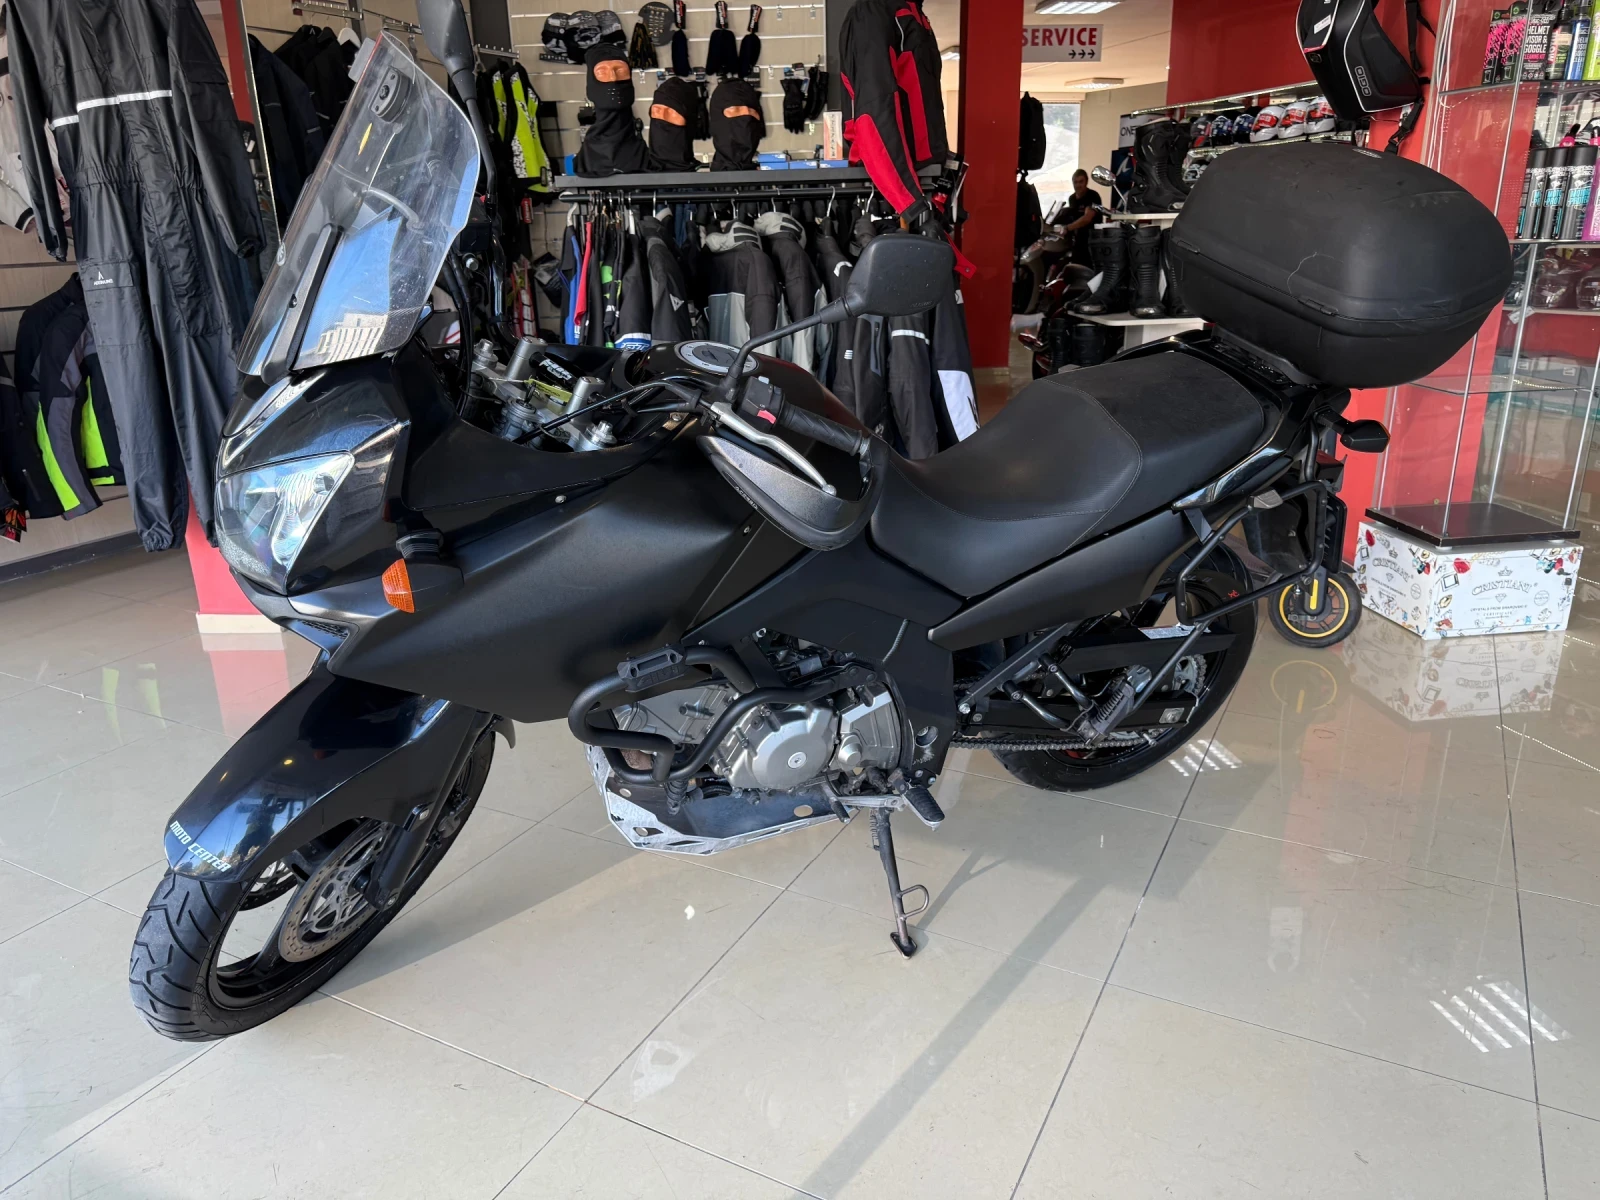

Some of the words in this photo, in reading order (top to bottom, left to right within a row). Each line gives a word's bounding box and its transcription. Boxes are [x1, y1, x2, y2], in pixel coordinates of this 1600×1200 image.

[1022, 27, 1098, 47] SERVICE
[1527, 25, 1550, 35] HELMET
[1524, 44, 1547, 54] GOGGLE
[1354, 65, 1372, 97] OGIO
[1471, 579, 1532, 595] CRISTIANI
[169, 820, 192, 845] MOTO
[187, 842, 232, 873] CENTER
